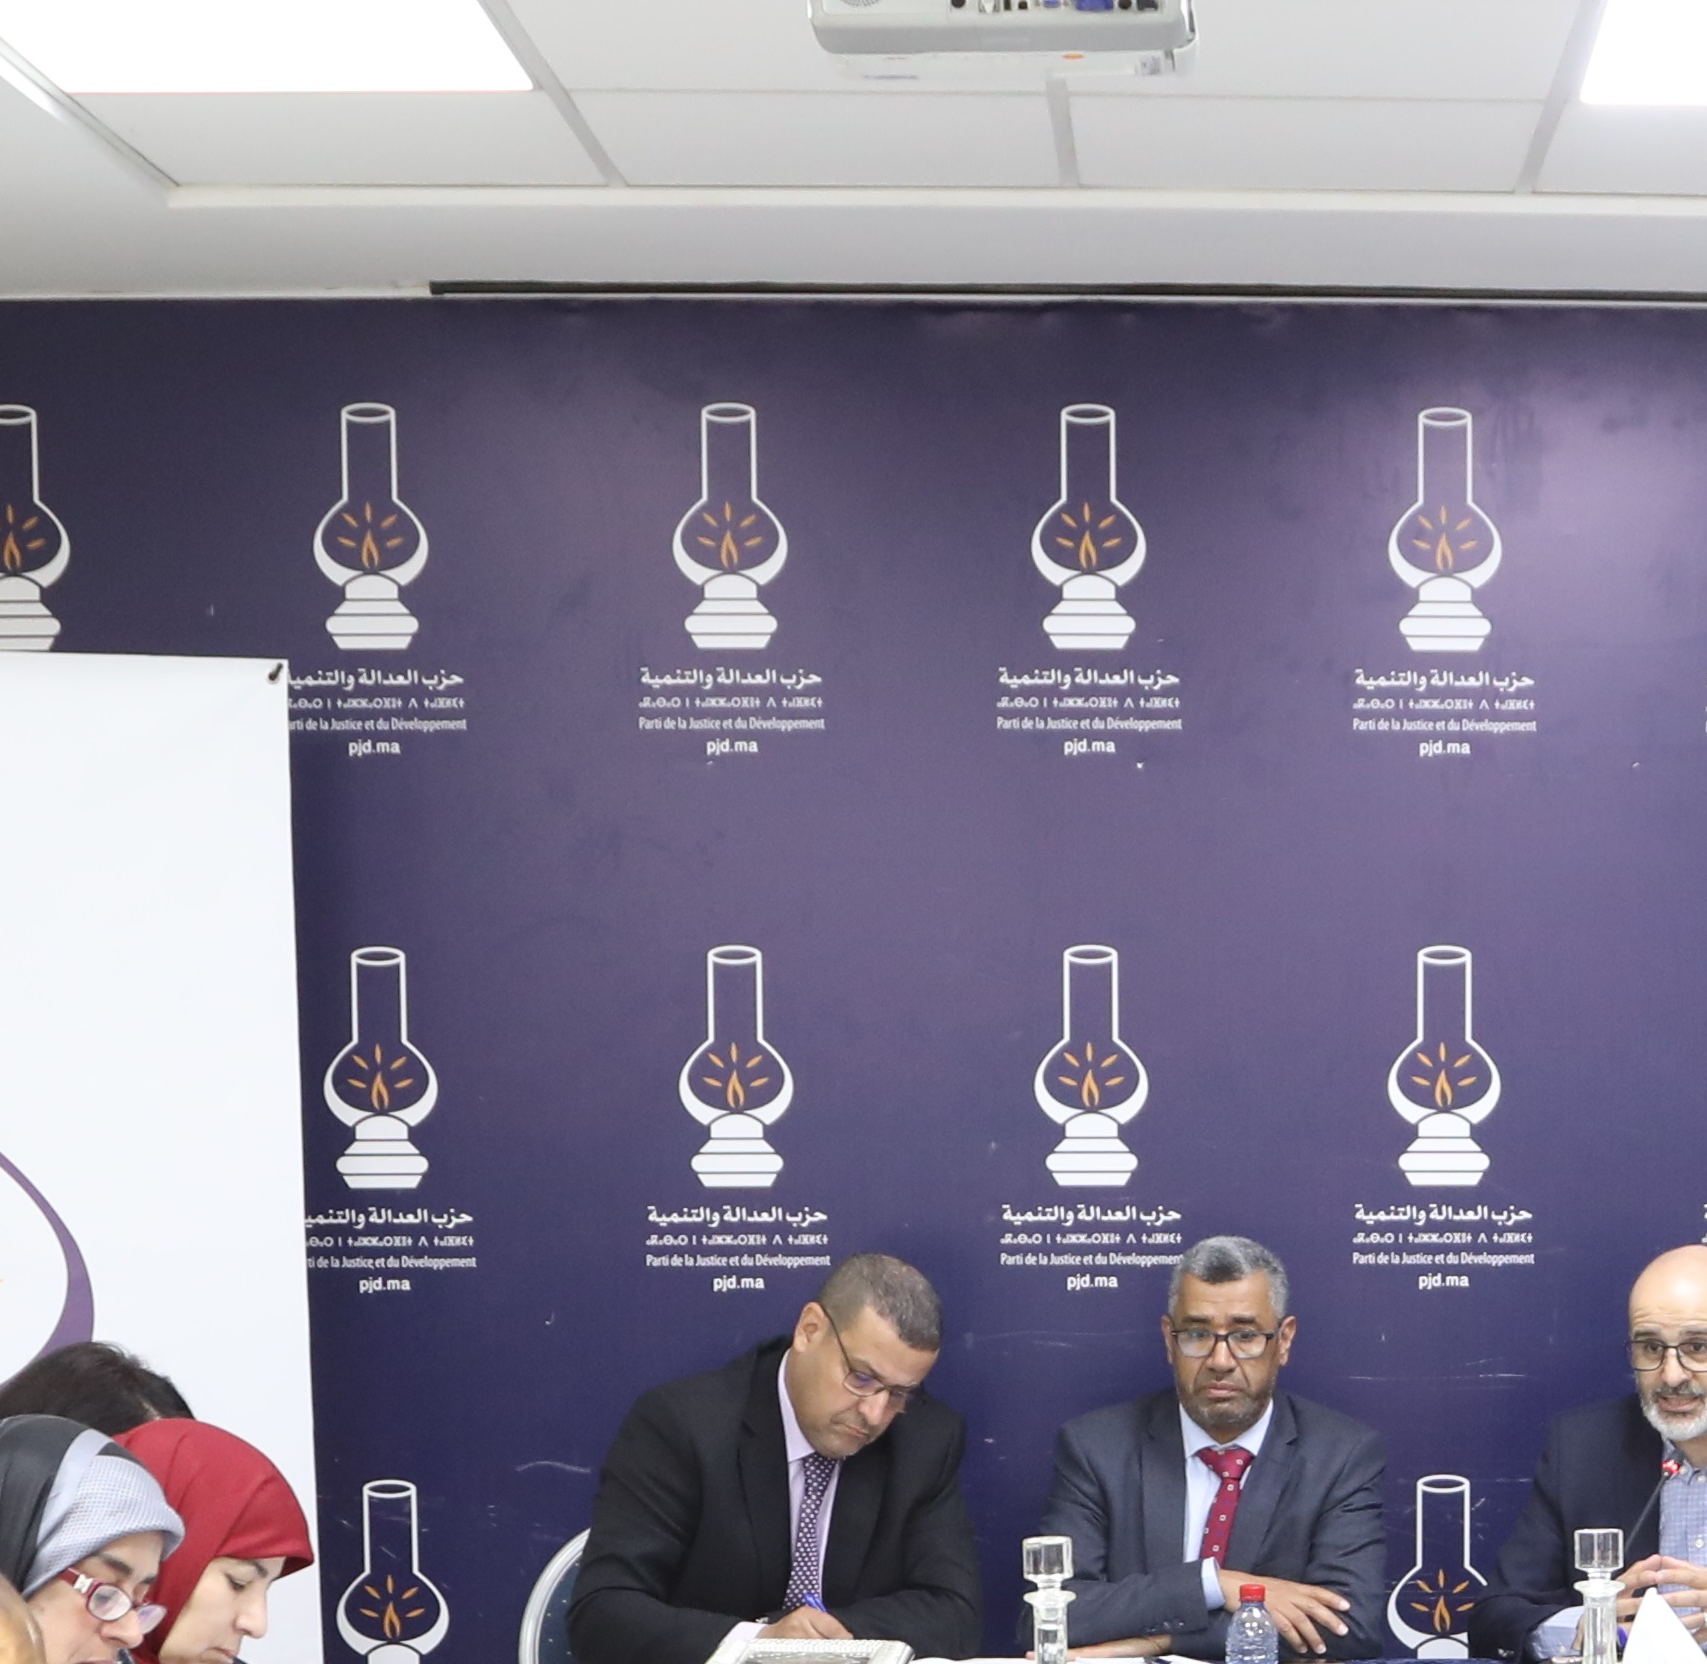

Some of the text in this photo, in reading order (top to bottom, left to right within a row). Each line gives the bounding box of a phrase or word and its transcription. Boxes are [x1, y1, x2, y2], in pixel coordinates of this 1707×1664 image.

[288, 668, 462, 691] حزب العدالة والتنمي
[639, 667, 823, 689] حزب العدالة والتنمية
[998, 667, 1181, 690] حزب العدالة والتنمية
[1354, 669, 1535, 692] حزب العدالة والتنمية
[638, 717, 826, 732] Parti de la Justice et du Développement
[996, 716, 1183, 732] Parti de la Justice et du Développement
[1352, 718, 1538, 734] Parti de la Justice et du Développement
[348, 740, 401, 757] pjd.ma
[706, 739, 758, 755] pjd.ma
[1063, 739, 1116, 756] pjd.ma
[1418, 740, 1470, 757] pjd.ma
[305, 1207, 474, 1229] حزب العدالة والتنمي
[646, 1205, 829, 1227] حزب العدالة والتنمية
[1001, 1204, 1183, 1226] حزب العدالة والتنمية
[1354, 1204, 1533, 1226] حزب العدالة والتنمية
[645, 1254, 832, 1269] Parti de la Justice et du Développement
[999, 1253, 1024, 1265] Parti
[1024, 1253, 1037, 1265] de
[1038, 1253, 1048, 1265] la
[1049, 1253, 1082, 1265] Justice
[1083, 1255, 1094, 1265] et
[1095, 1253, 1109, 1265] du
[1352, 1252, 1536, 1267] Parti de la Justice et du Développement
[358, 1277, 411, 1294] pjd.ma
[712, 1275, 765, 1292] pjd.ma
[1066, 1274, 1119, 1291] pjd.ma
[1418, 1273, 1469, 1290] pjd.ma
